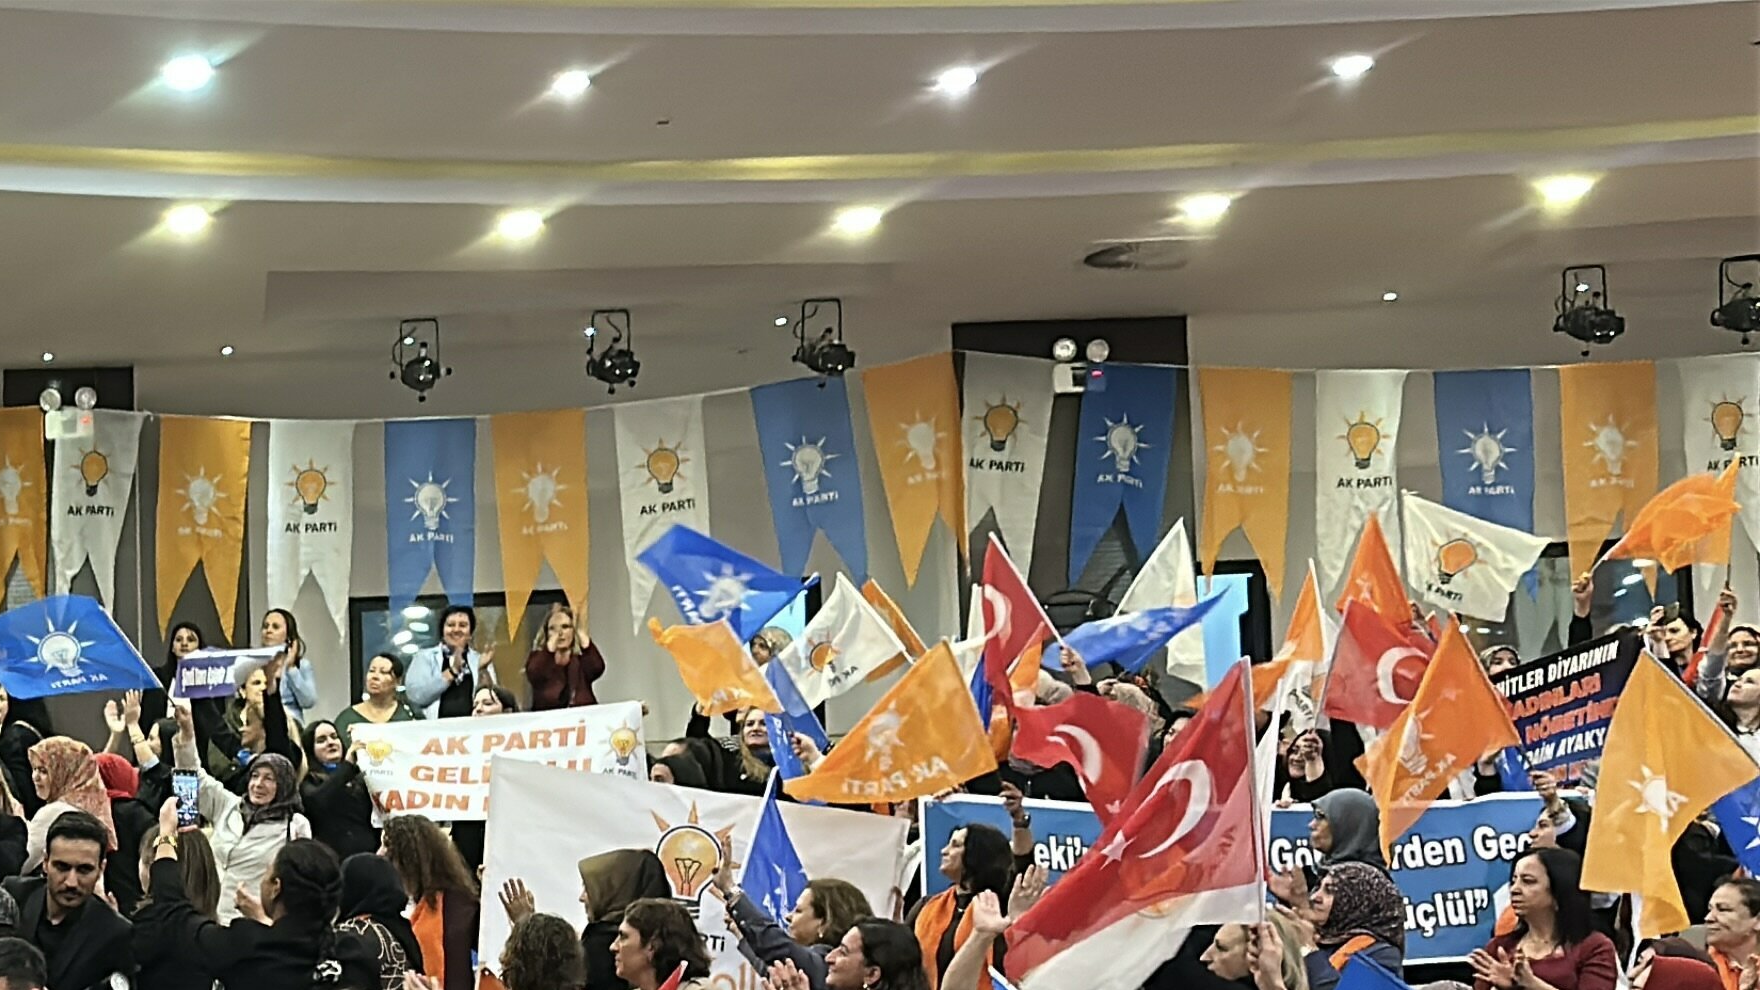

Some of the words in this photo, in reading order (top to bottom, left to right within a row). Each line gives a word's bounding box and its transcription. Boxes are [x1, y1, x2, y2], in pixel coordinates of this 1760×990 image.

[1723, 455, 1759, 470] PRTI
[67, 505, 83, 517] AK
[639, 503, 657, 515] AK
[285, 522, 301, 533] AK
[420, 734, 471, 756] AK
[481, 719, 587, 753] PARTİ
